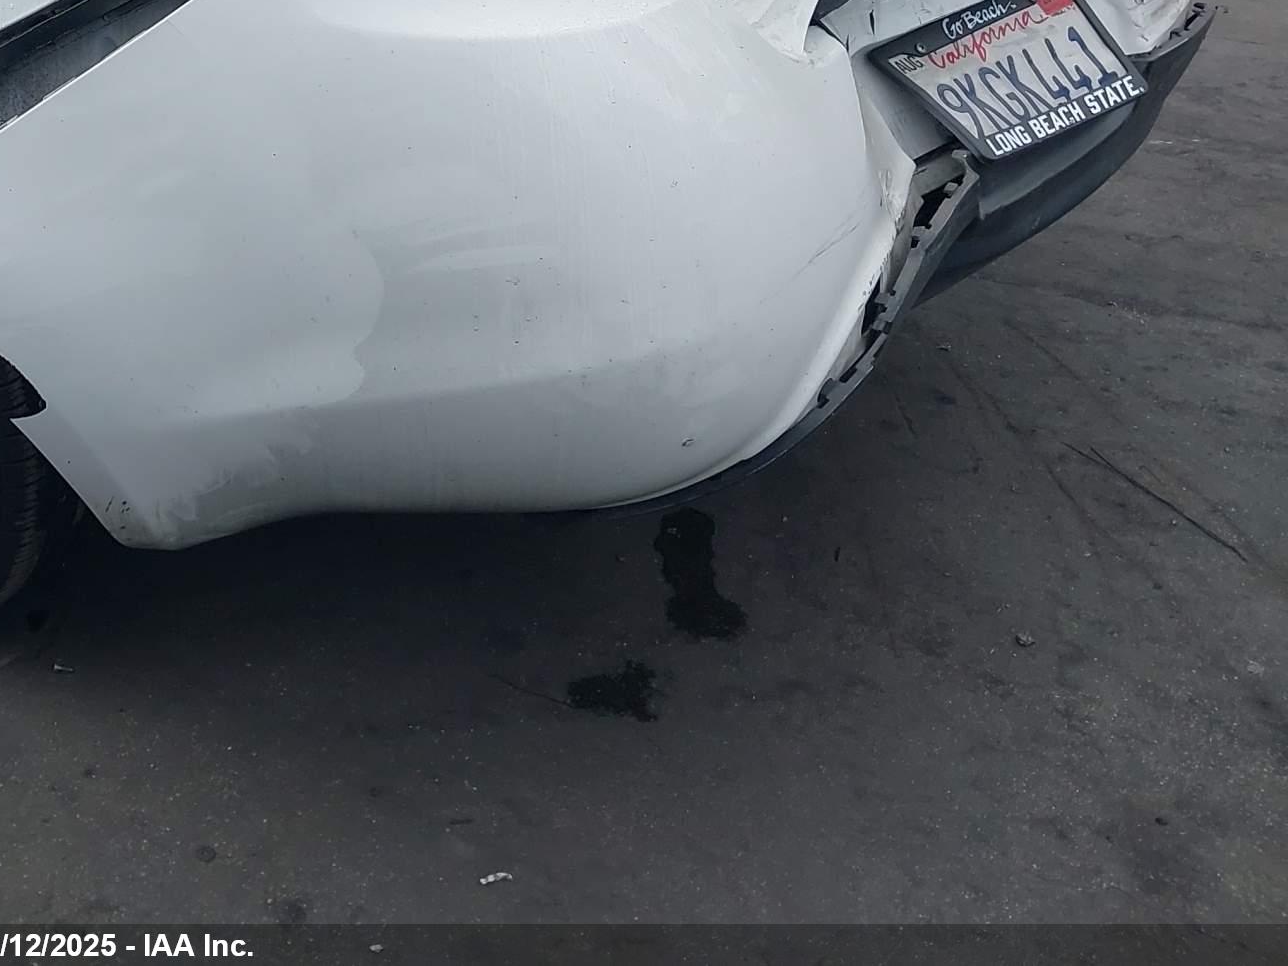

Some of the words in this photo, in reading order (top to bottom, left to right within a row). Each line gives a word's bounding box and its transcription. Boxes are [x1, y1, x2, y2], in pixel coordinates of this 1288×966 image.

[928, 9, 1048, 69] California
[942, 18, 963, 39] Go
[895, 56, 924, 74] AUG
[986, 125, 1031, 155] LONG
[1028, 99, 1086, 138] BEACH
